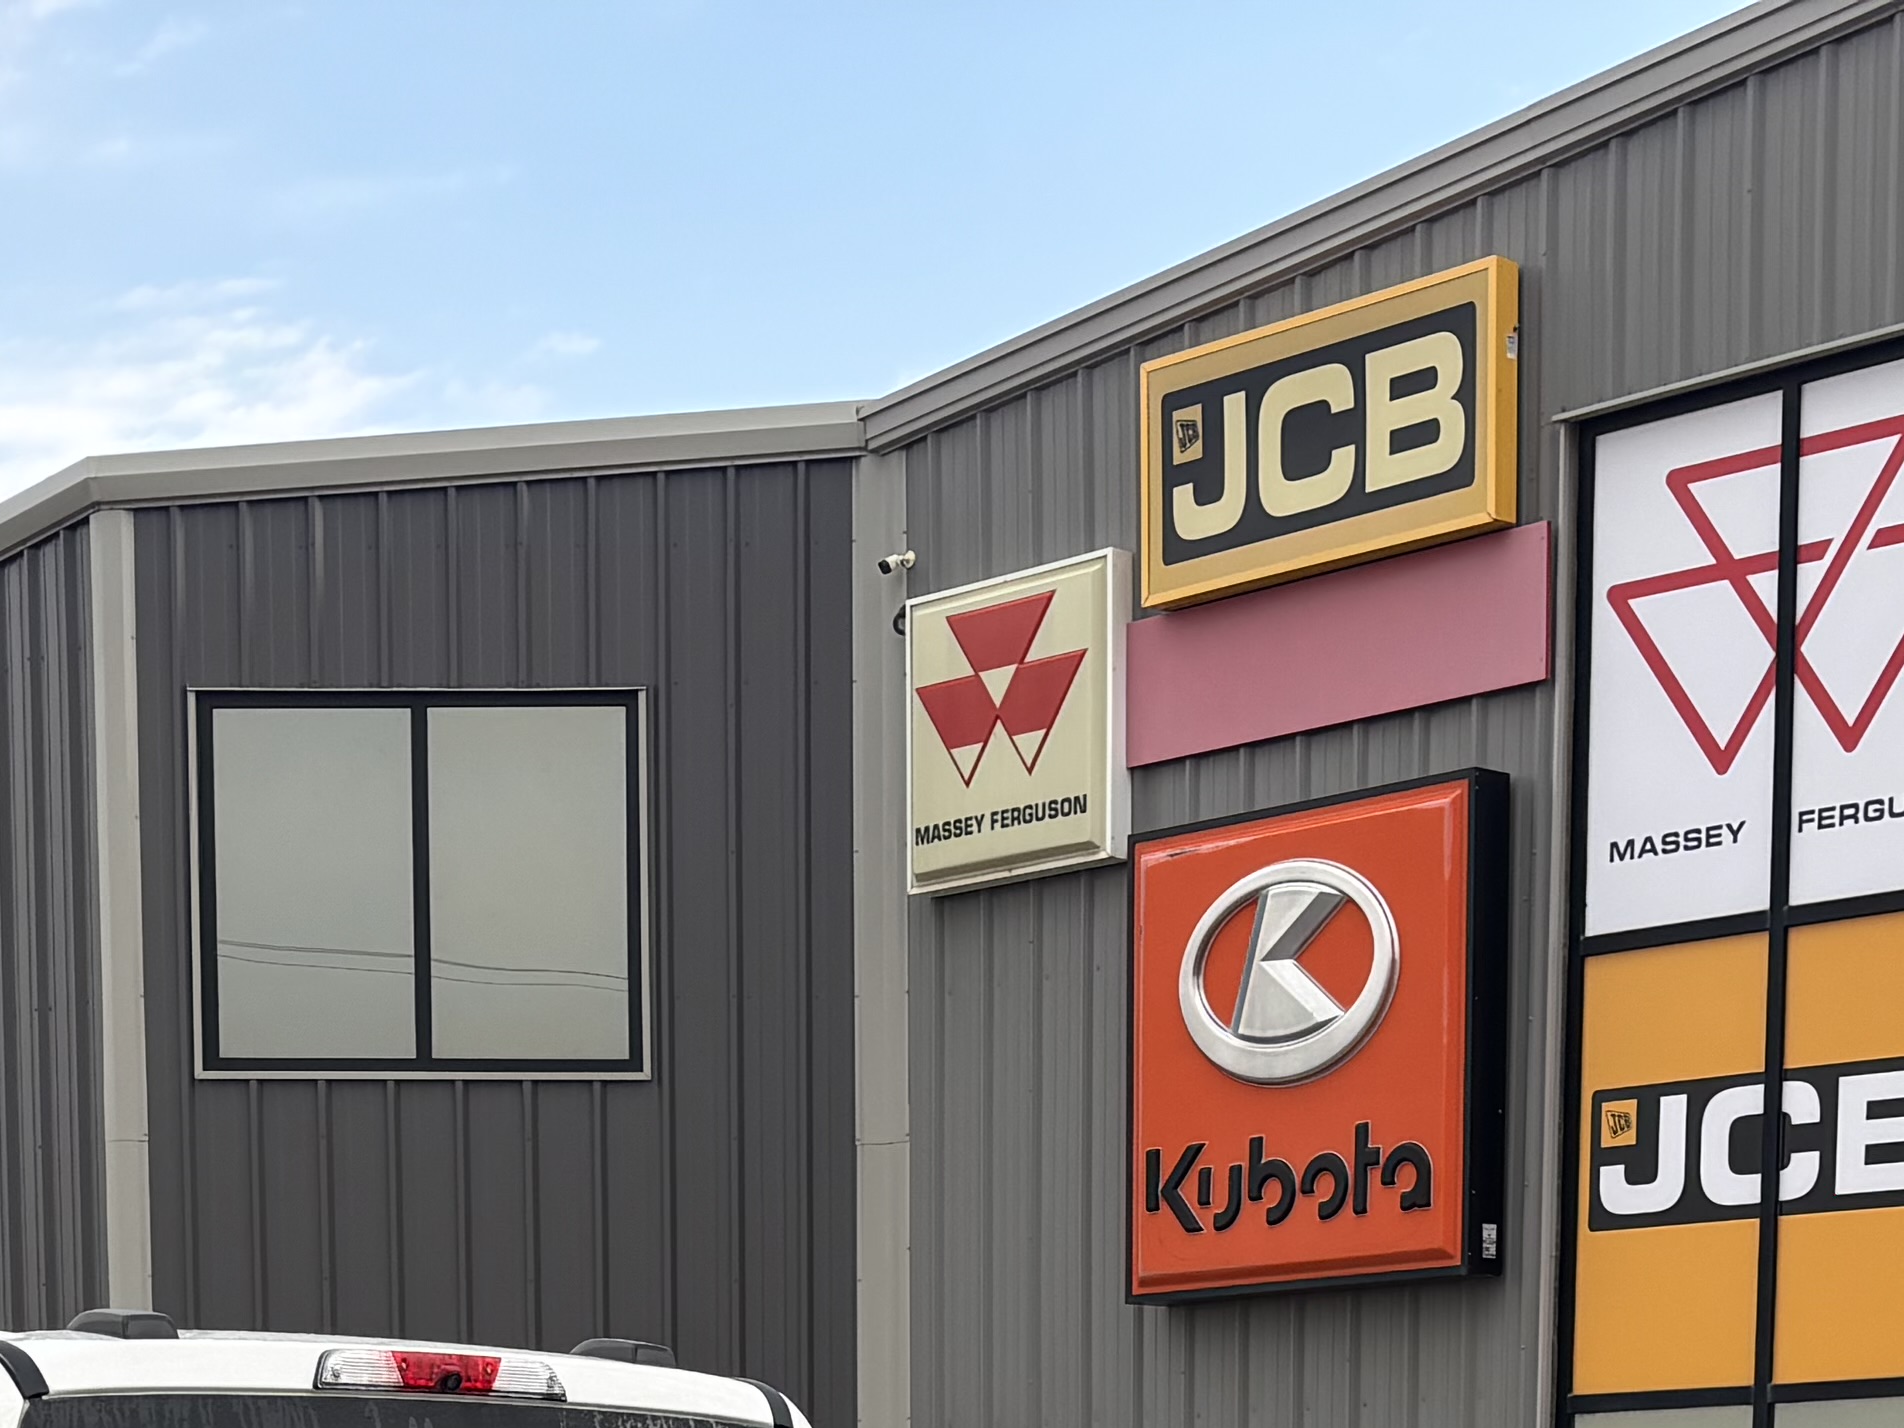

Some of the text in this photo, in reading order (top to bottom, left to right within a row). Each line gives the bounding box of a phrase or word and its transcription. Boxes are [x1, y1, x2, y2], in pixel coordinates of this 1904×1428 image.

[1172, 331, 1465, 540] JCB
[915, 793, 1087, 847] MASSEY FERGUSON
[1608, 820, 1746, 863] MASSEY
[1145, 1121, 1433, 1234] Kubota
